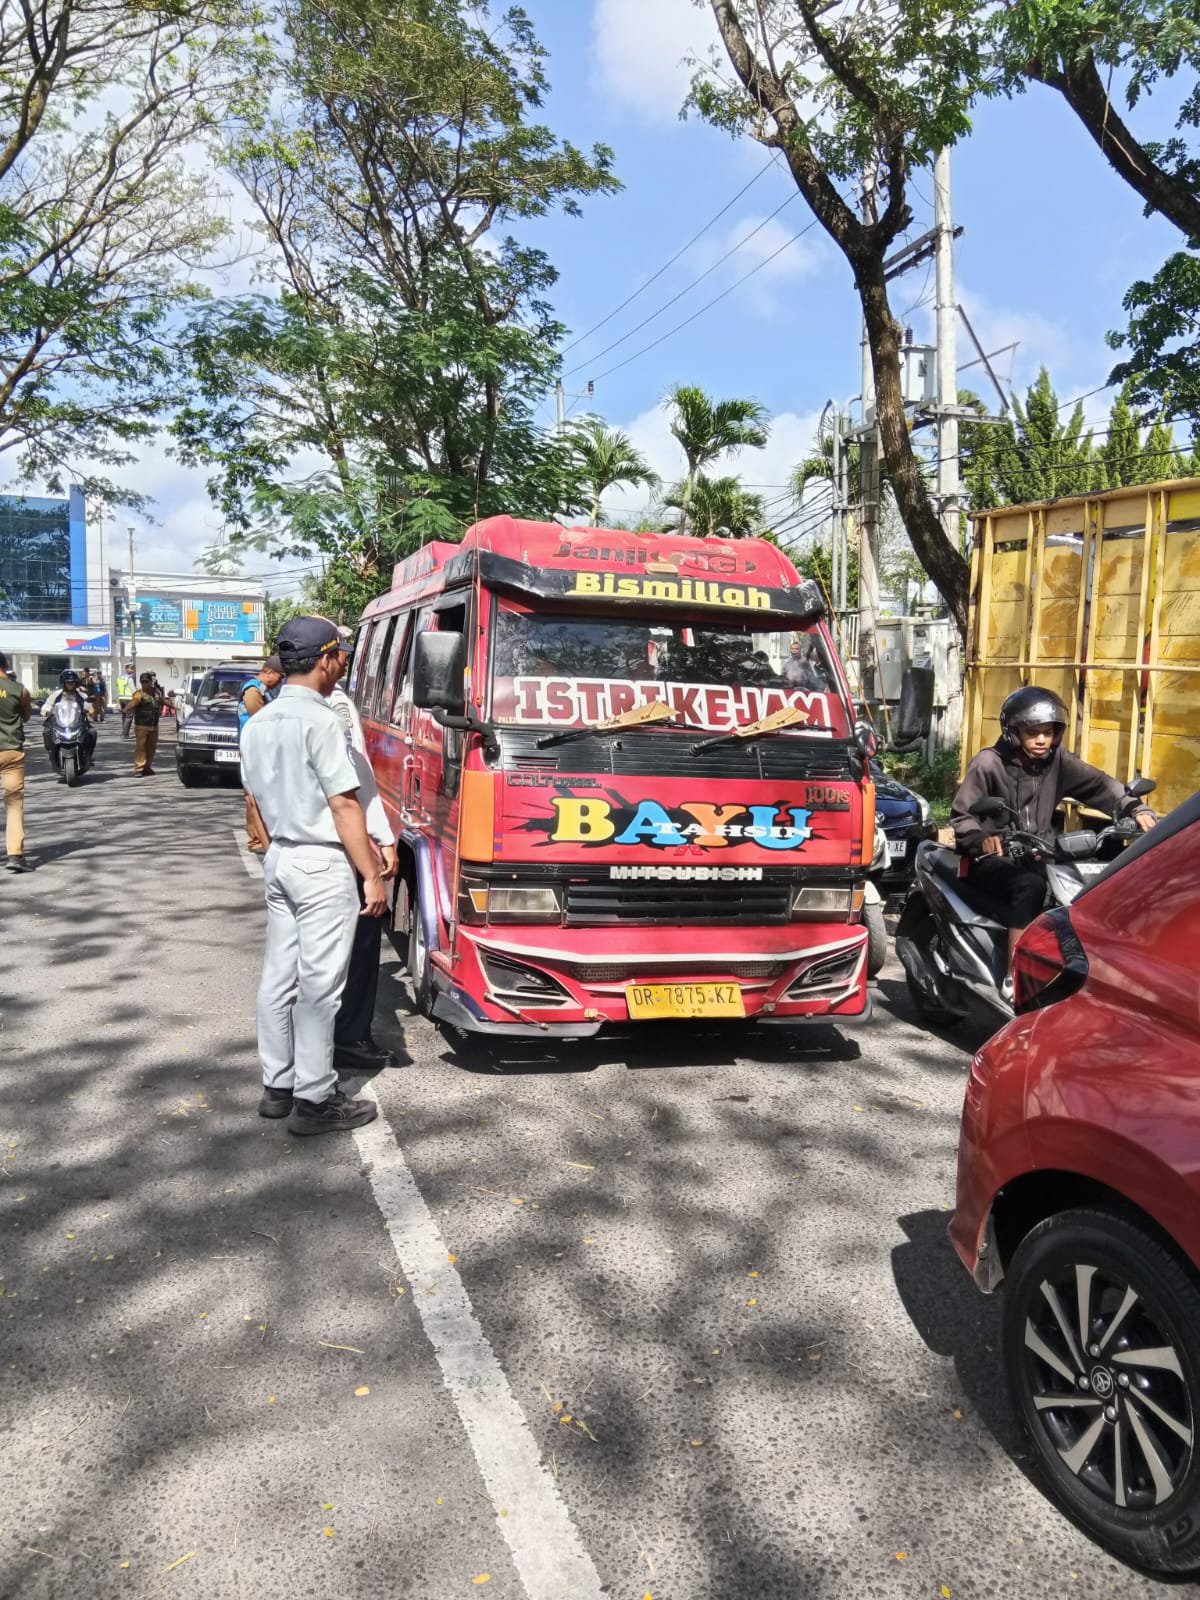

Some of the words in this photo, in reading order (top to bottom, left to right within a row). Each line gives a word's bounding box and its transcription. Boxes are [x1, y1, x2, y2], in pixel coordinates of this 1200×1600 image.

[574, 571, 771, 609] Bismillah
[551, 797, 813, 850] BAYU
[653, 822, 813, 840] TAHSIN
[609, 865, 763, 881] MITSUBISHI
[633, 988, 655, 1006] DR
[664, 987, 706, 1005] 7875
[714, 986, 736, 1004] KZ
